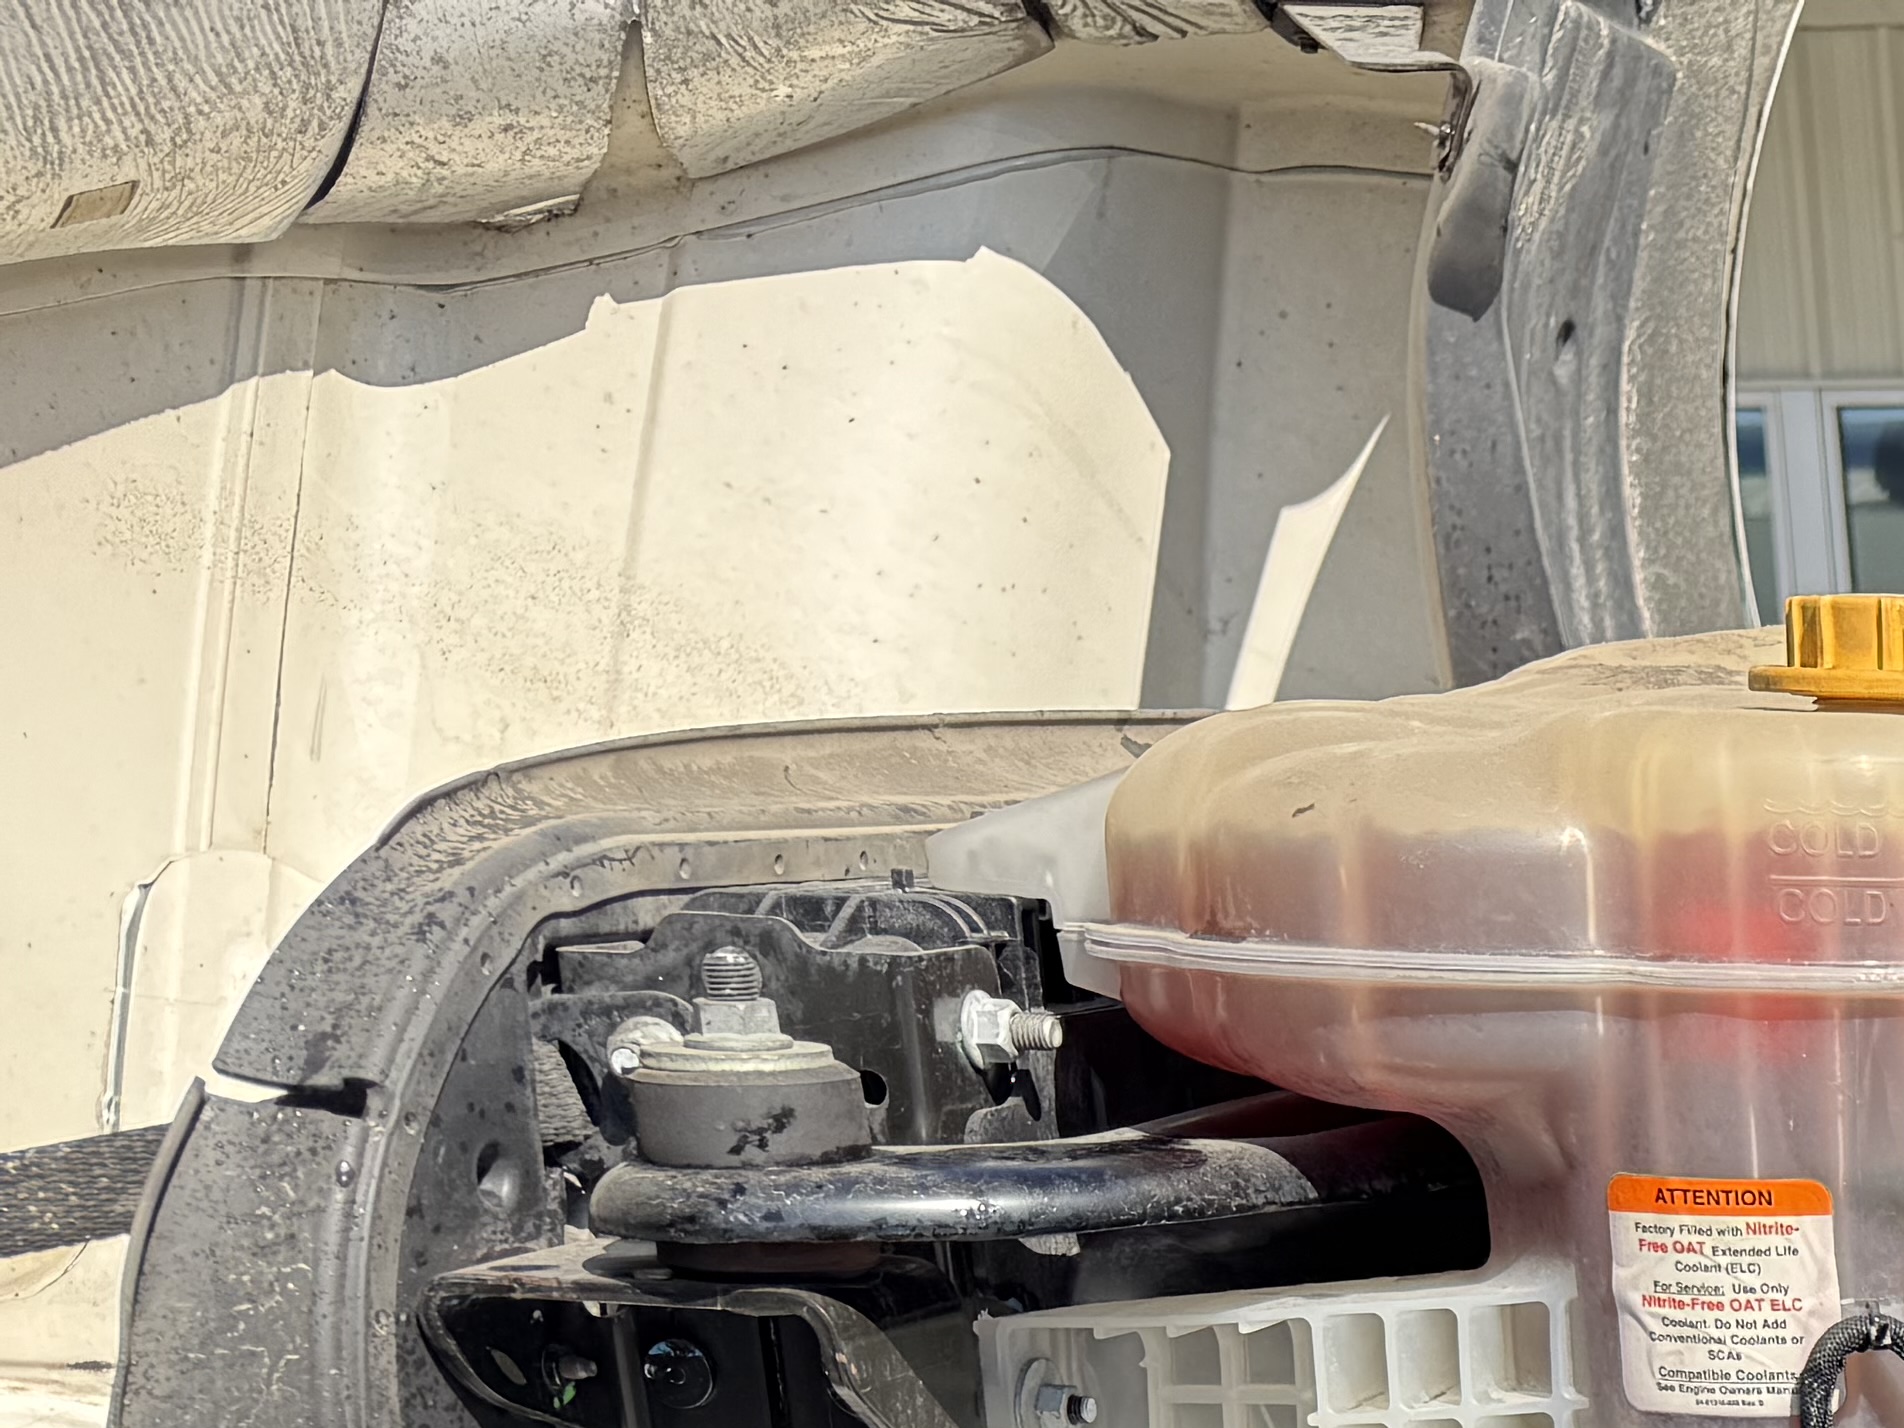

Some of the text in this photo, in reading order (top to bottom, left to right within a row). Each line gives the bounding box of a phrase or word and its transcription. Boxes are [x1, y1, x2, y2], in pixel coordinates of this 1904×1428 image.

[1768, 820, 1882, 857] COLD
[1779, 889, 1886, 925] COLD
[1655, 1188, 1773, 1206] ATTENTION
[1635, 1222, 1799, 1238] Factory Filled with Nitrite-
[1639, 1239, 1799, 1257] Free OAT Extended Life
[1675, 1261, 1761, 1275] Coolant (ELC)
[1654, 1281, 1789, 1297] For Service: Use Only
[1642, 1295, 1802, 1311] Nitrite-Free OAT ELC
[1715, 1318, 1731, 1329] Do
[1735, 1318, 1758, 1330] Not
[1762, 1319, 1786, 1330] Add
[1650, 1332, 1804, 1346] Conventional Coolants or
[1708, 1349, 1742, 1360] SCAs
[1659, 1367, 1731, 1382] Compatible
[1657, 1382, 1715, 1395] See Engine
